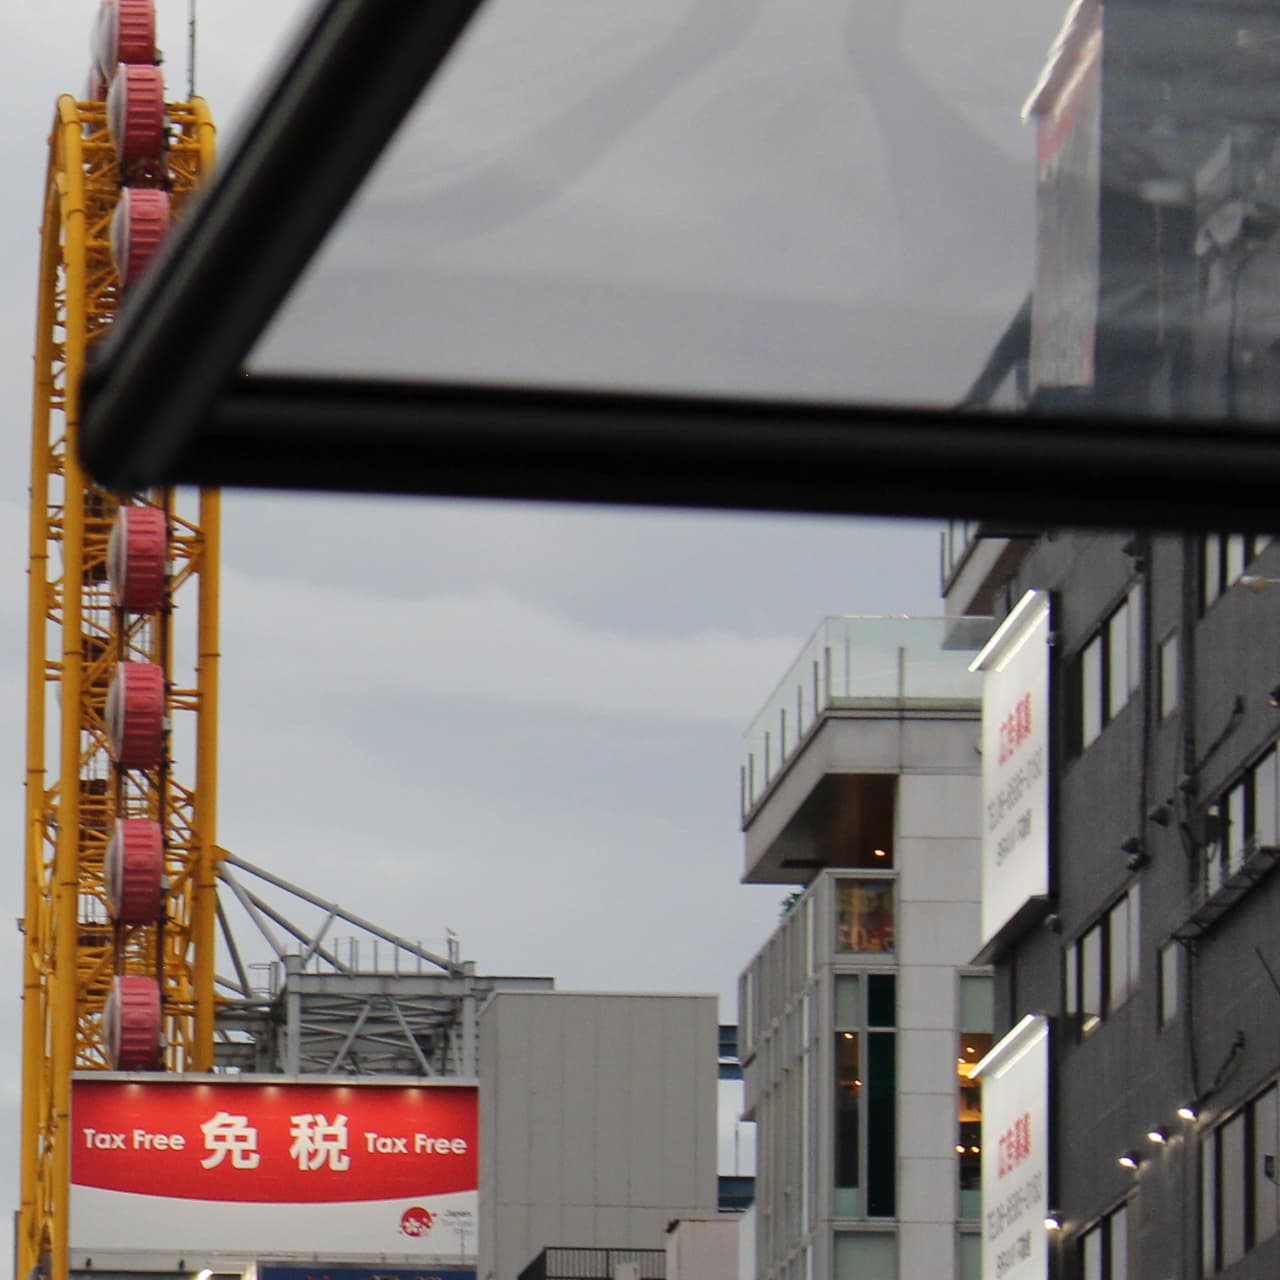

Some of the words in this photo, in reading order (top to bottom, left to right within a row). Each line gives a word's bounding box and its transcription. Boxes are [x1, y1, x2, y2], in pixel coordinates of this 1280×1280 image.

[82, 1127, 126, 1150] Tax
[132, 1129, 186, 1151] Free
[364, 1132, 408, 1154] Tax
[414, 1133, 468, 1155] Free
